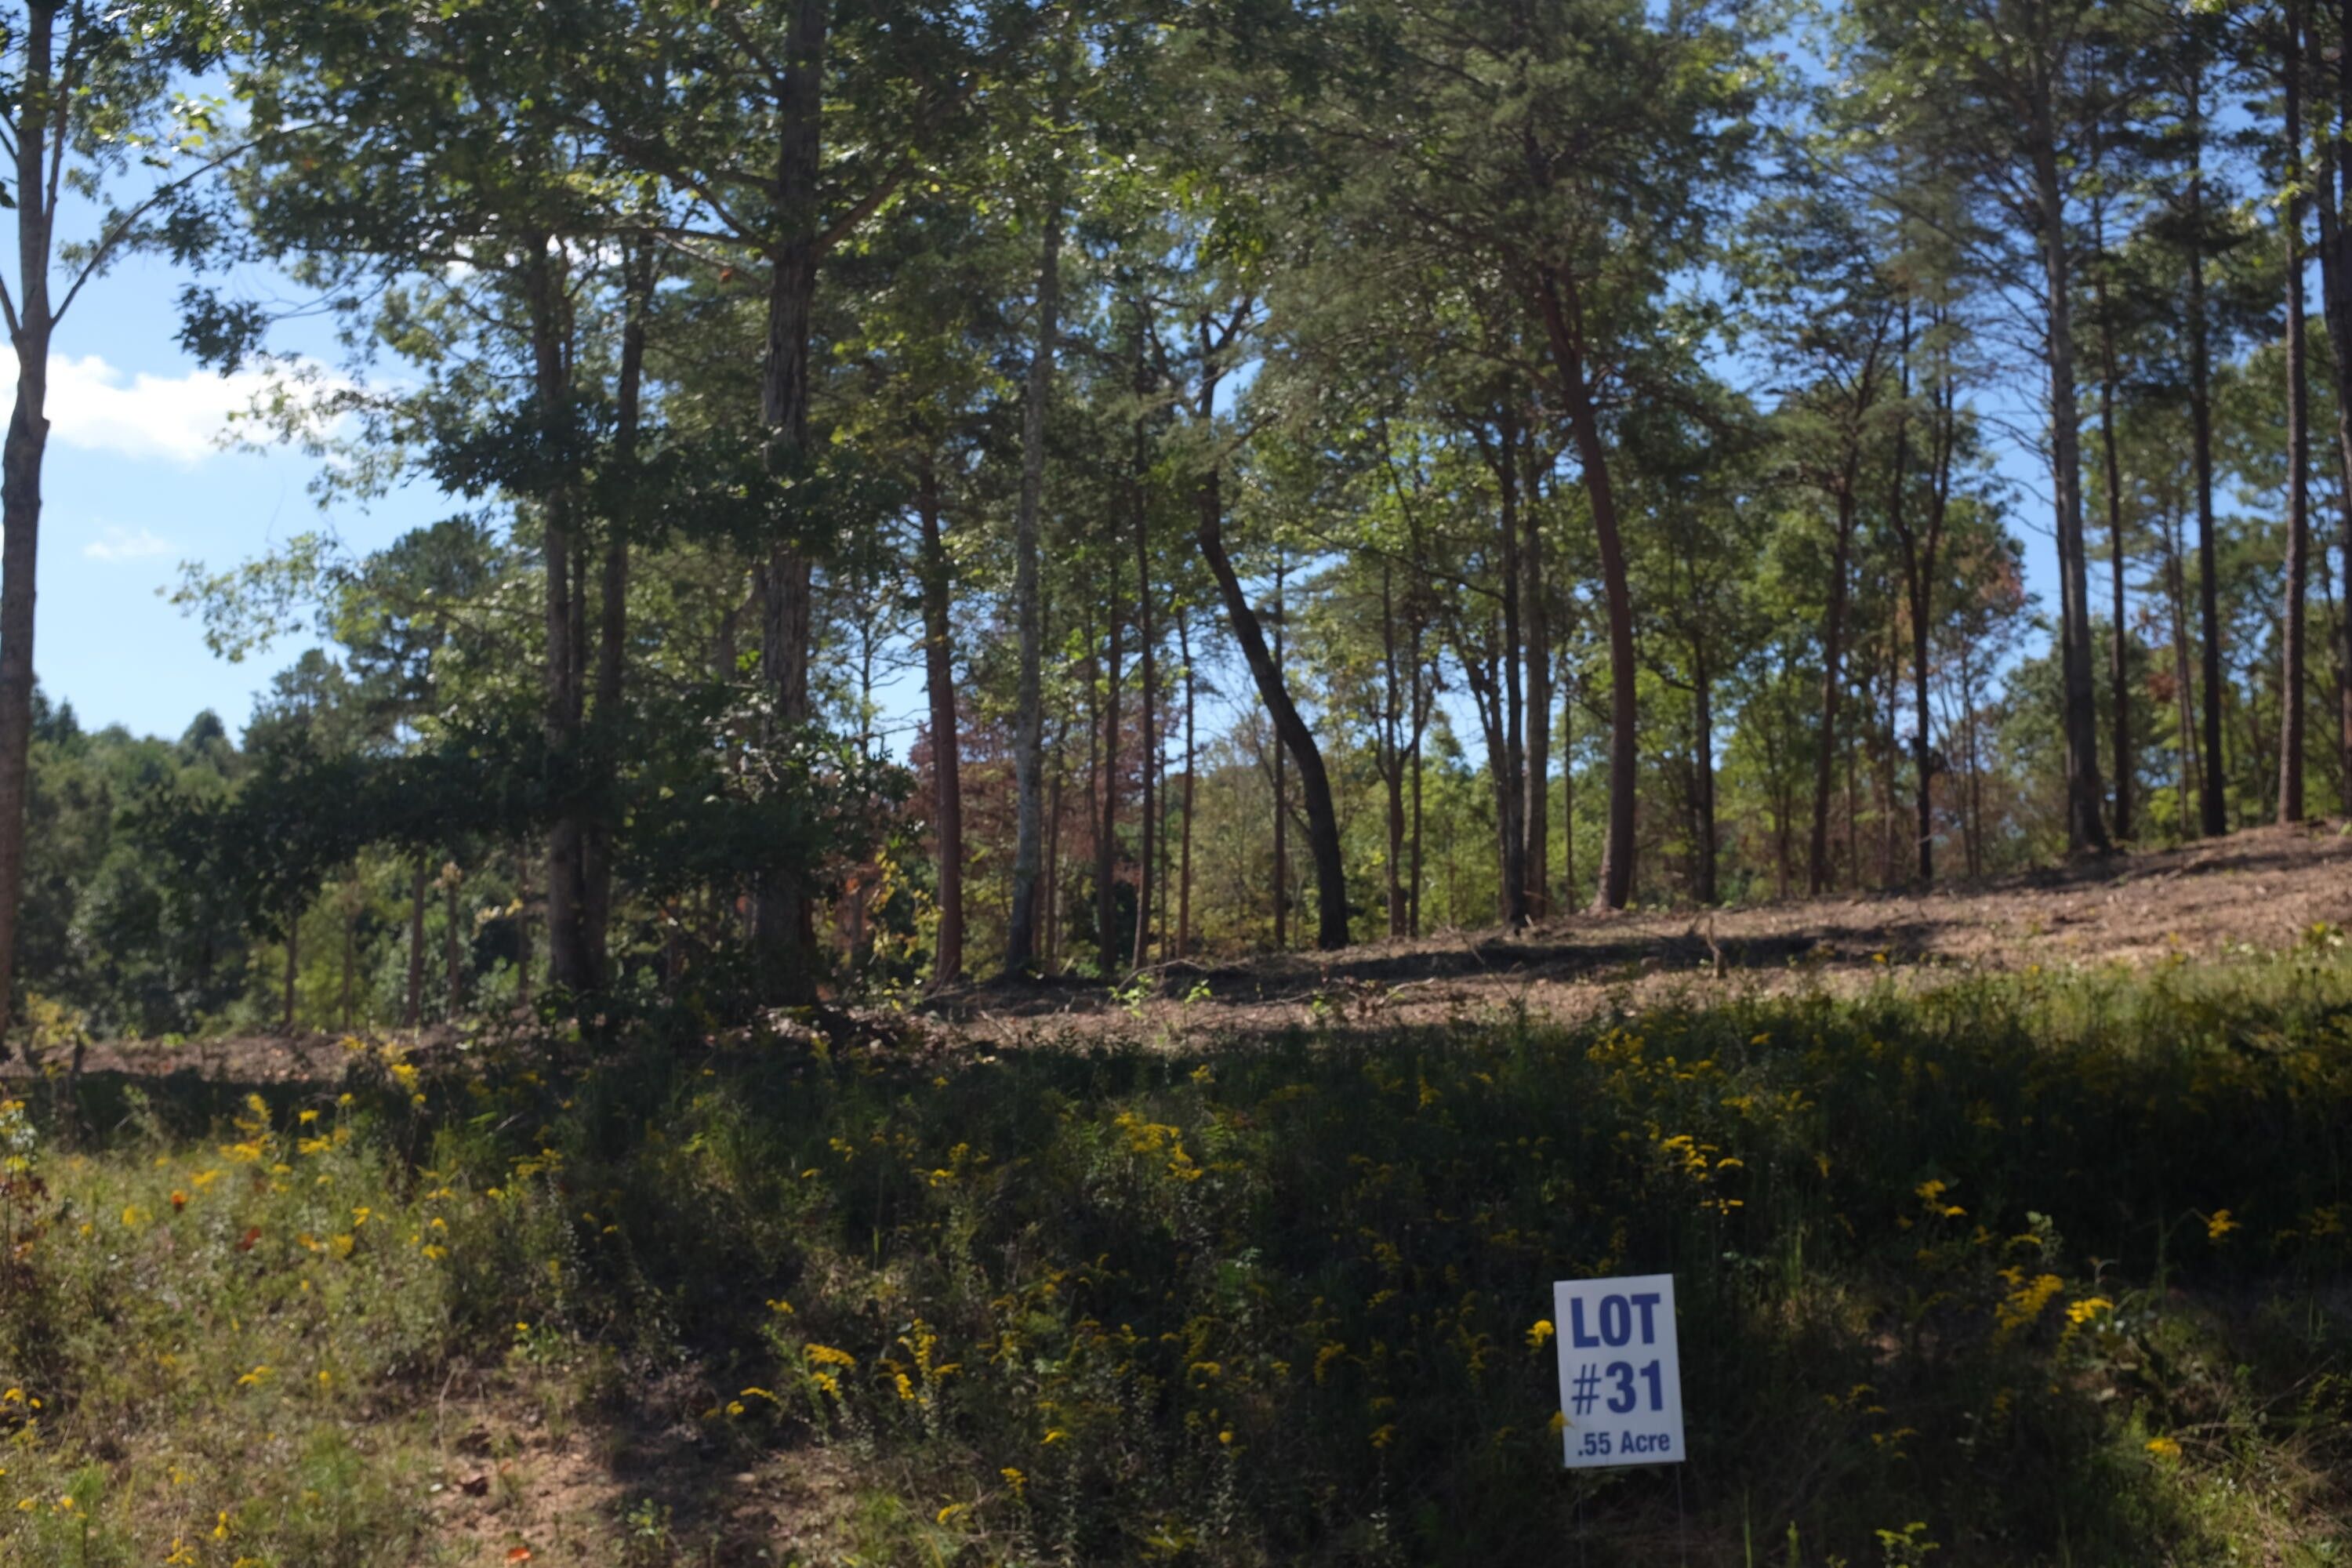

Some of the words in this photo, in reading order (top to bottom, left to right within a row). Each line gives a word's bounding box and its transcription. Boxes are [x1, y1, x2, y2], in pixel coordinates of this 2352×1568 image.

[1570, 1293, 1661, 1348] LOT
[1571, 1359, 1663, 1415] #31
[1578, 1432, 1611, 1457] .55
[1620, 1430, 1671, 1454] Acre
